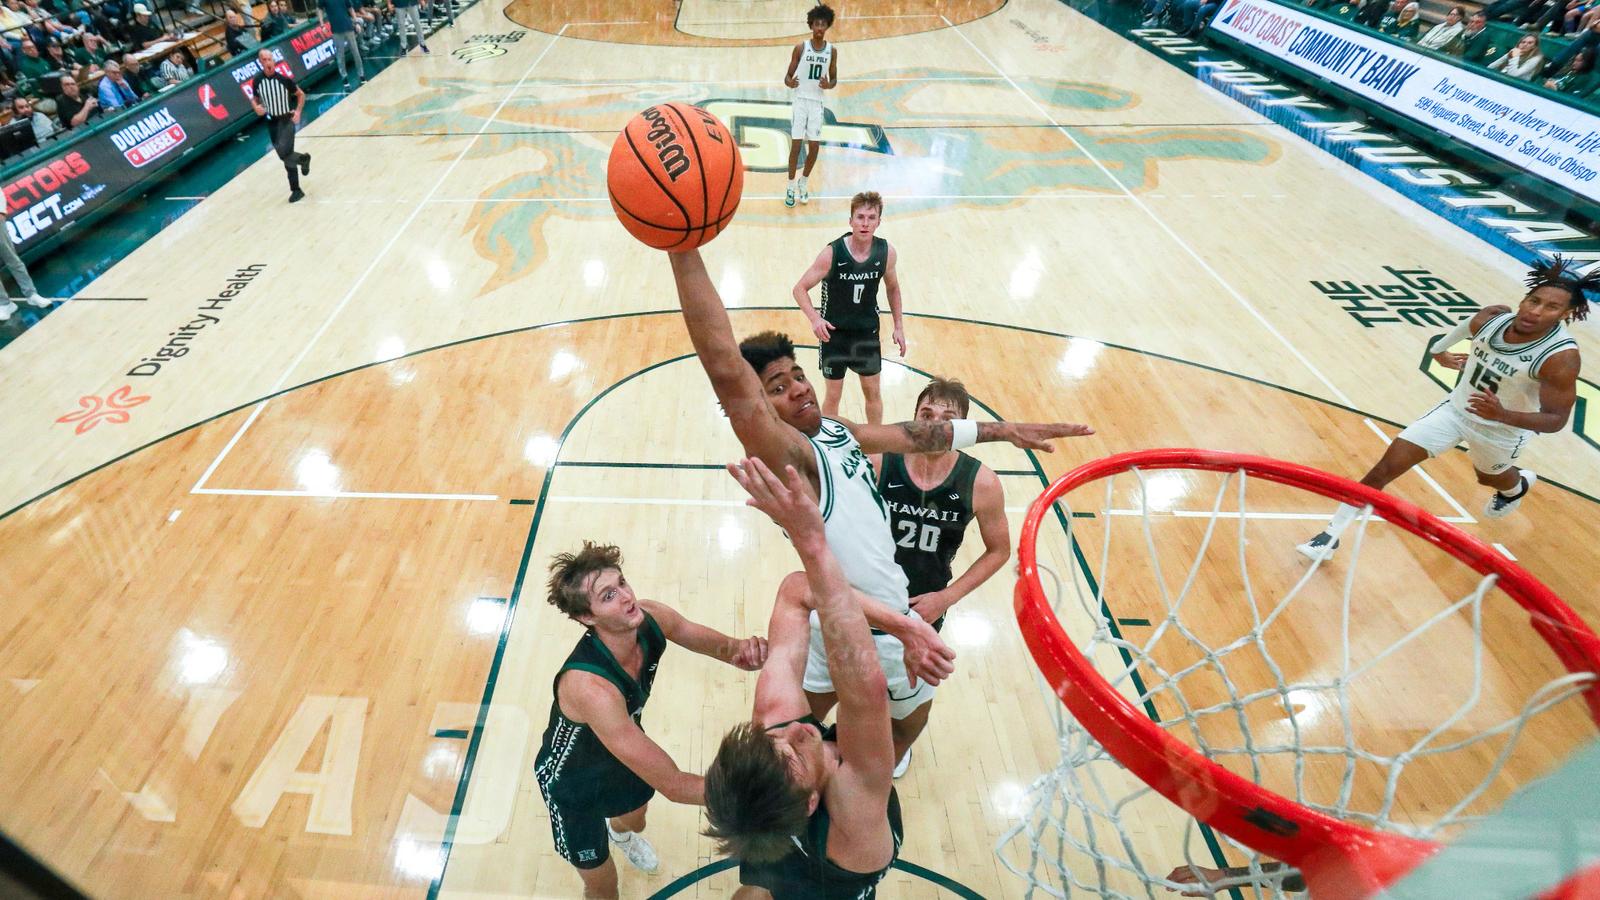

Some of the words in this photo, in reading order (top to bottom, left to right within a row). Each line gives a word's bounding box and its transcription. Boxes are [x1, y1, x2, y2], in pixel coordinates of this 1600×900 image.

[231, 58, 260, 84] POWER
[808, 63, 823, 80] 10
[816, 56, 828, 64] POLY
[1129, 28, 1209, 55] CAL
[1188, 60, 1331, 110] POLY
[1231, 3, 1269, 34] WEST
[1256, 13, 1302, 48] COAST
[1288, 26, 1378, 79] COMMUNITY
[1359, 54, 1421, 98] BANK
[110, 106, 177, 152] DURAMAX
[1433, 77, 1457, 95] Put
[1445, 88, 1479, 103] your
[1473, 97, 1514, 121] money
[1509, 109, 1549, 132] where
[1538, 125, 1582, 143] your
[137, 130, 177, 161] DIESEL
[640, 106, 691, 183] Wilson
[1414, 96, 1434, 111] 599
[1428, 101, 1460, 123] Higuera
[1456, 114, 1487, 136] Street,
[1482, 125, 1509, 144] Suite
[1504, 134, 1519, 147] B
[1518, 139, 1541, 158] San
[1536, 147, 1562, 167] Luis
[1558, 156, 1598, 182] Obispo
[1, 151, 92, 214] CTORS
[853, 283, 865, 304] 0
[1309, 280, 1403, 328] THE
[1362, 284, 1458, 328] BIG
[1382, 265, 1482, 321] EST
[126, 313, 220, 376] Dignity
[198, 263, 267, 310] Health
[1469, 362, 1502, 395] 15
[1473, 346, 1489, 363] CAL
[1491, 357, 1518, 377] POLY
[896, 519, 942, 553] 20
